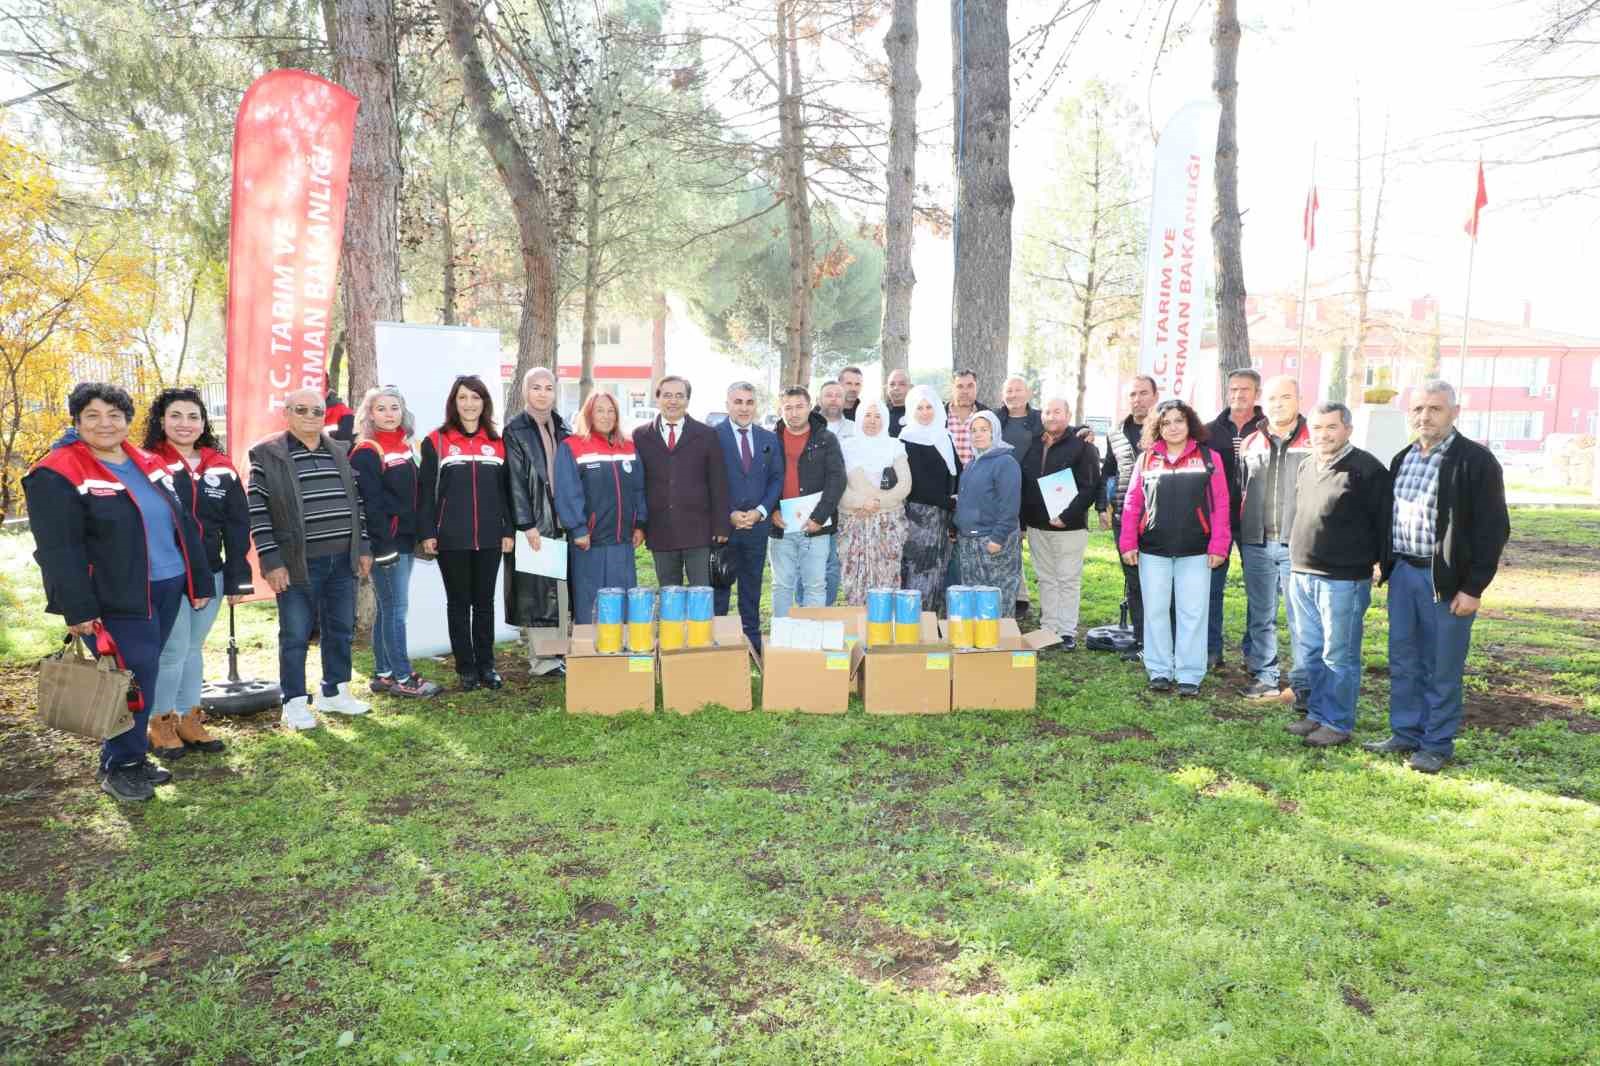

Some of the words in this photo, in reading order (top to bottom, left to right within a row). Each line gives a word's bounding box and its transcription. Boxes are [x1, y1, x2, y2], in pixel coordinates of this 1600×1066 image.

[272, 216, 297, 257] VE
[303, 144, 333, 300] BAKANLIĞI
[1164, 227, 1176, 259] VE
[1178, 154, 1201, 295] BAKANLIĞI
[272, 264, 296, 355] TARIM
[302, 306, 328, 393] RMAN
[1156, 267, 1173, 346] TARIM
[1173, 301, 1191, 396] ORMAN
